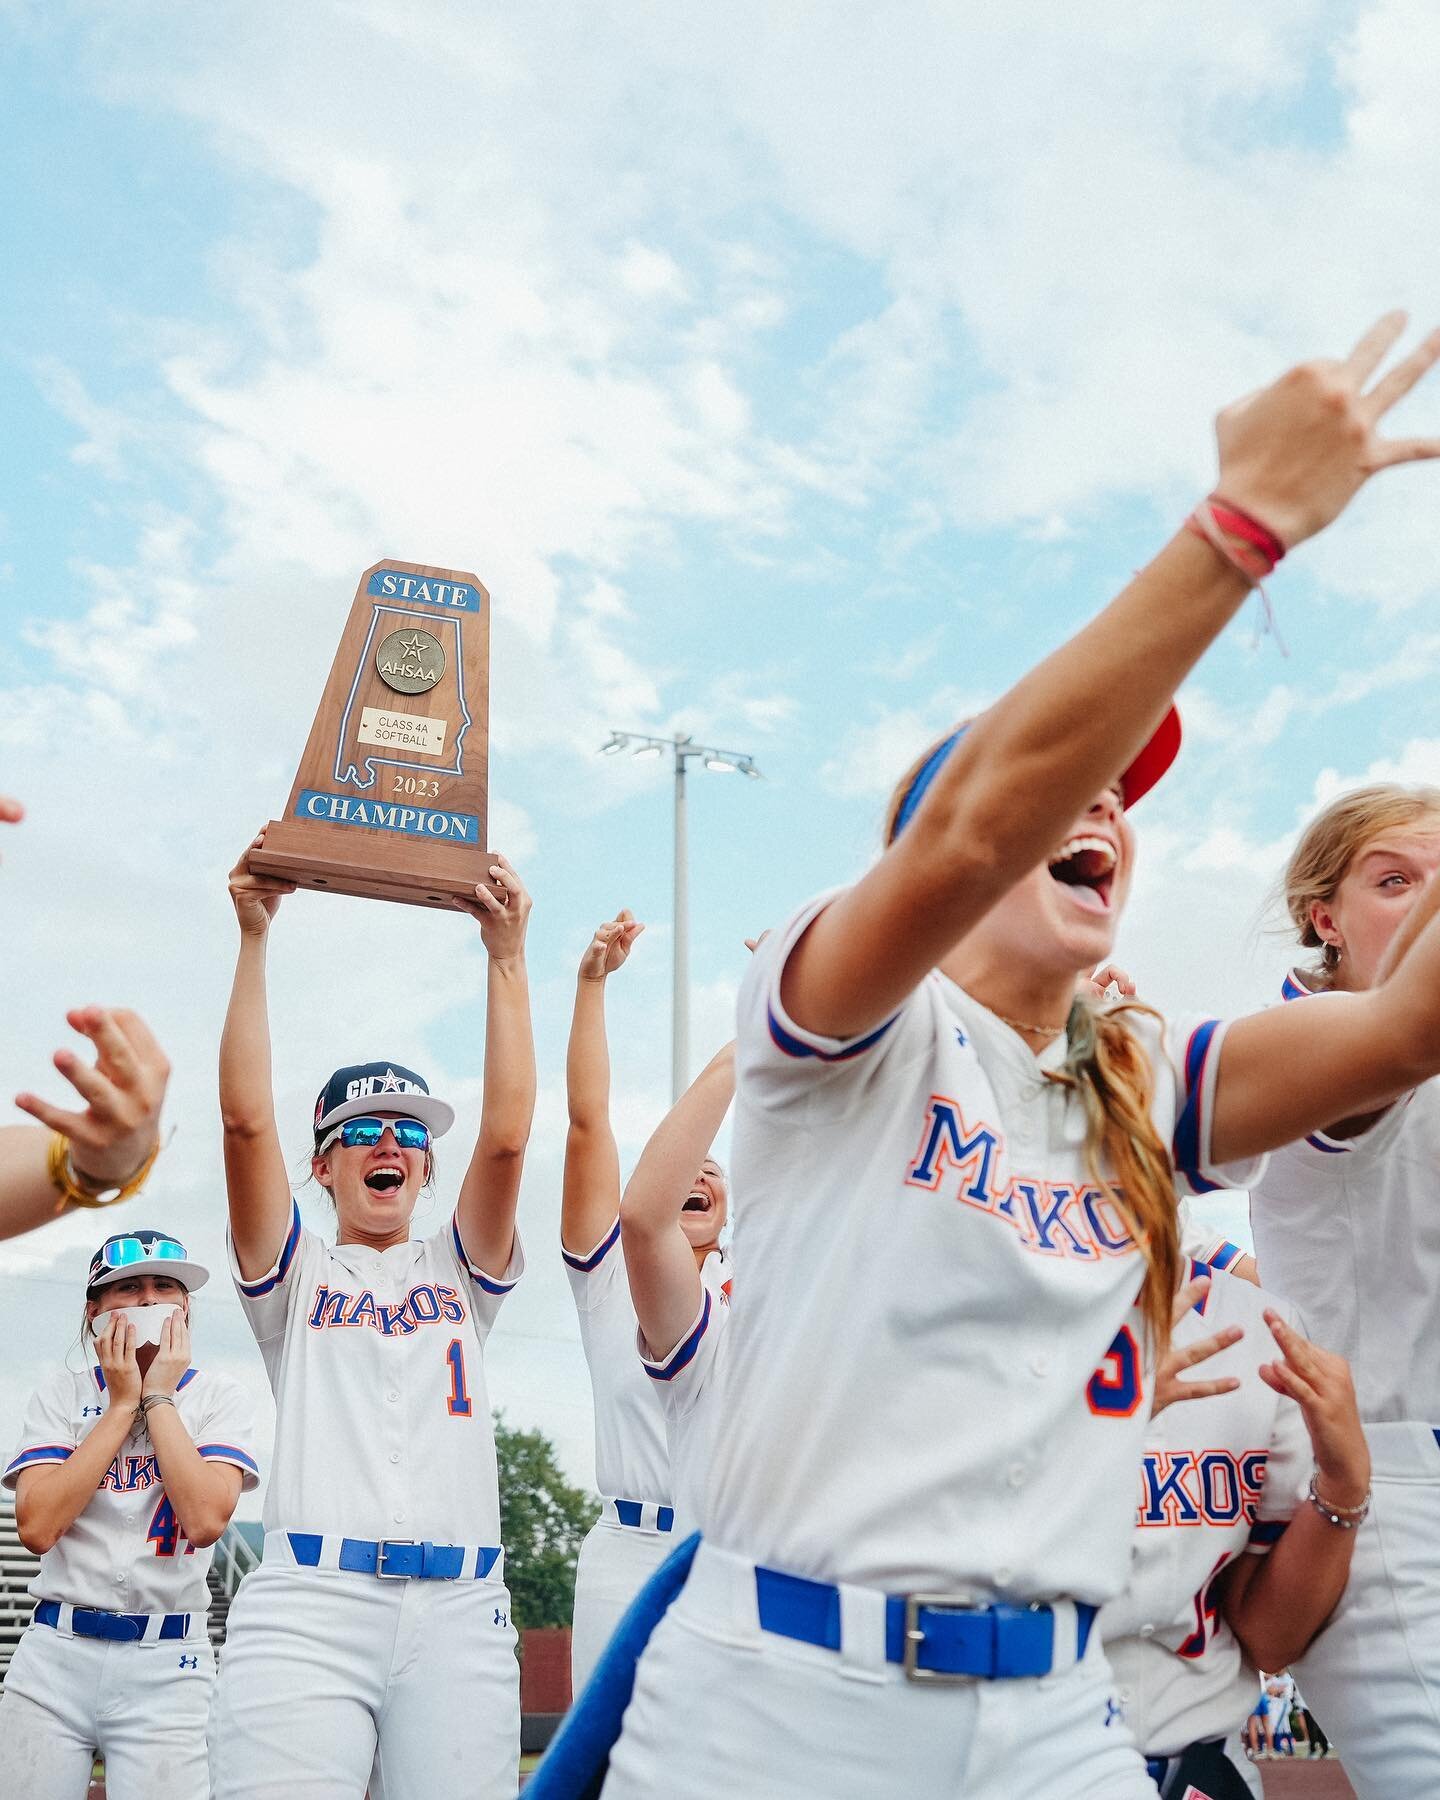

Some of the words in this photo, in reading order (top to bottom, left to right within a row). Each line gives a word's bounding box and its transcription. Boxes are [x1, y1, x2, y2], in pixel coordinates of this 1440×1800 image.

[381, 575, 468, 607] STATE
[380, 661, 437, 683] AHSAA
[374, 729, 428, 746] SOFTBALL
[378, 716, 413, 731] CLASS
[415, 723, 429, 733] 4A
[392, 775, 441, 798] 2023
[307, 795, 470, 838] CHAMPION
[308, 1284, 465, 1337] MAKOS
[446, 1338, 472, 1417] 1
[146, 1492, 196, 1556] 4
